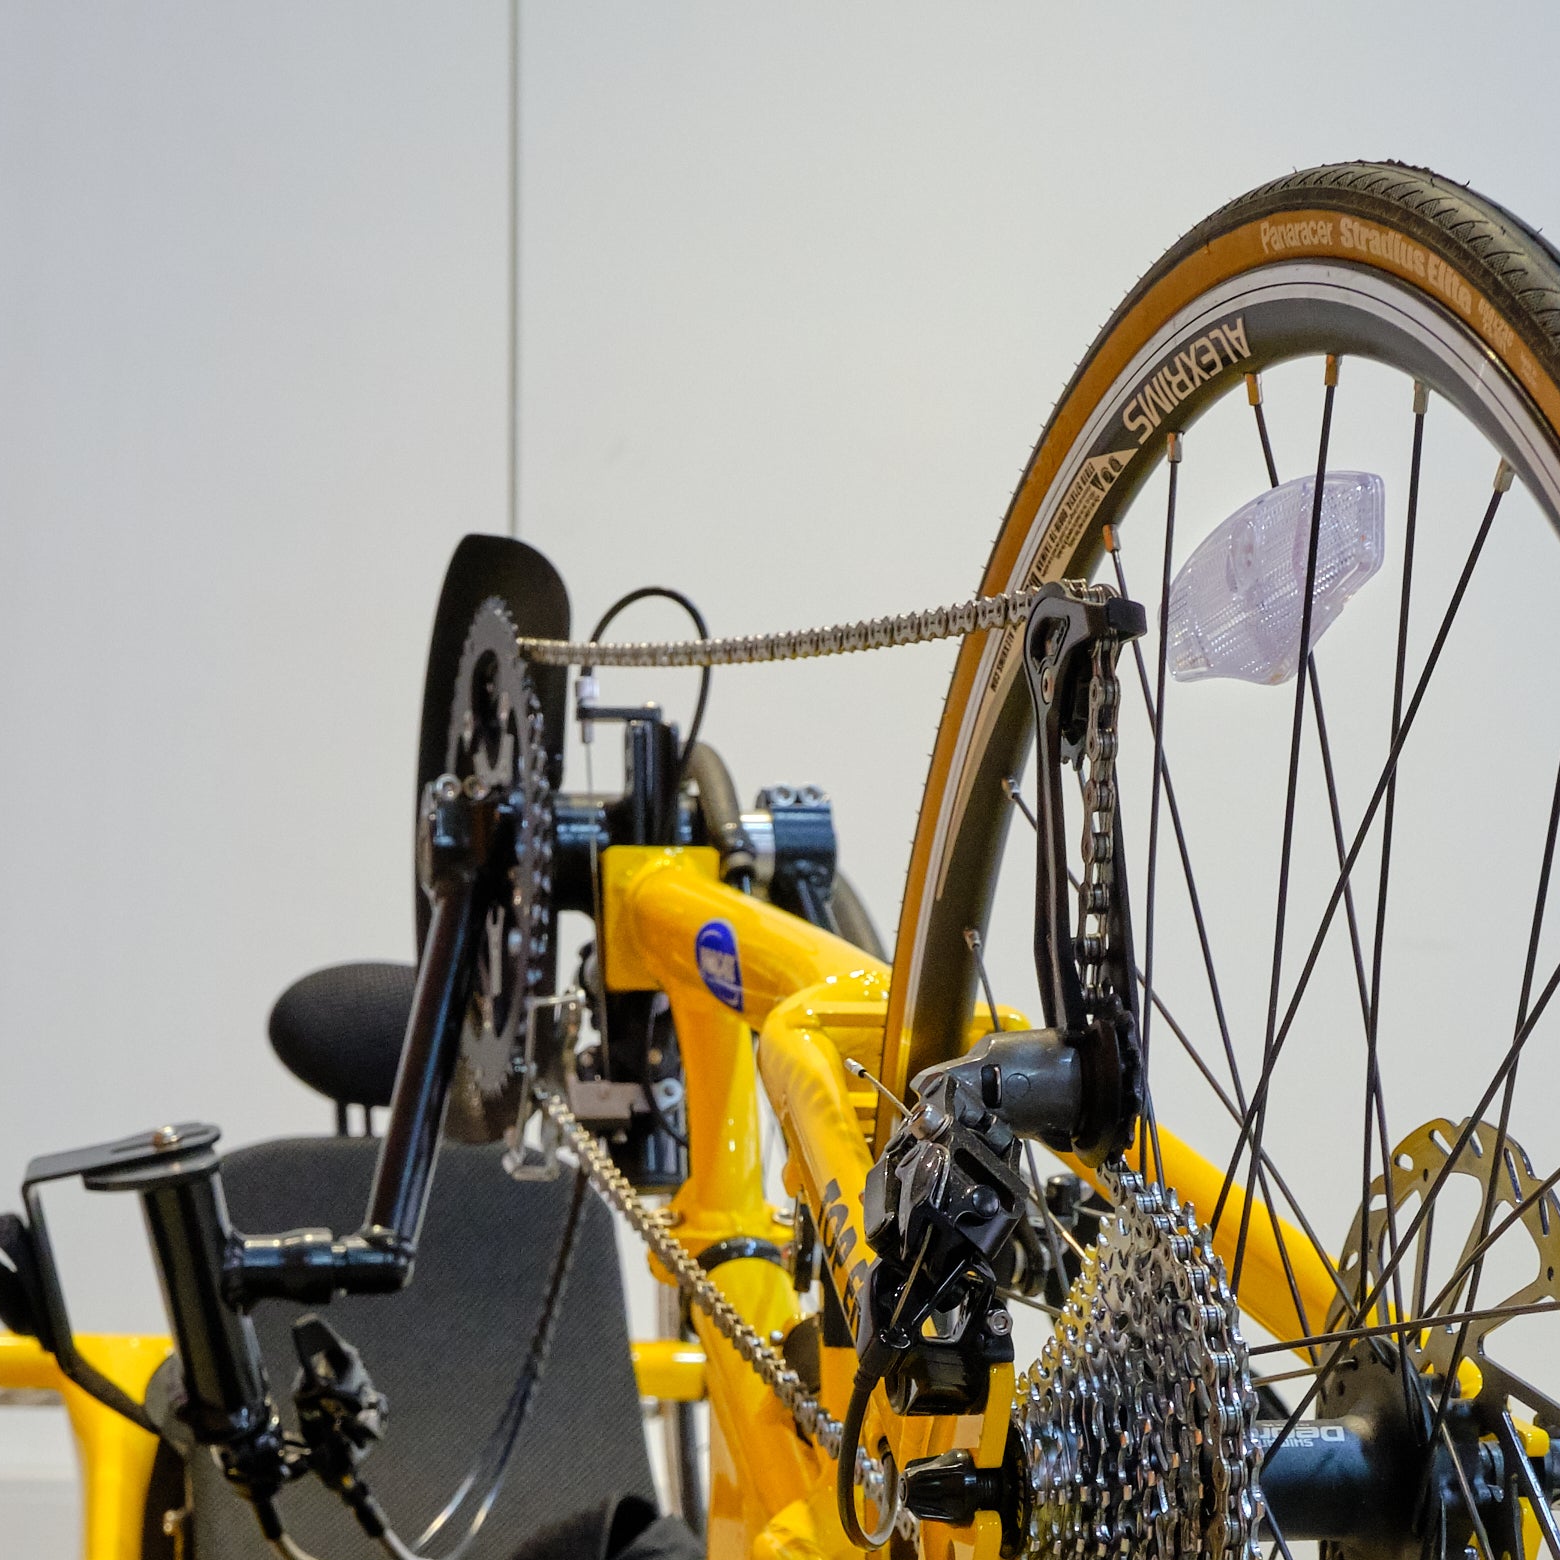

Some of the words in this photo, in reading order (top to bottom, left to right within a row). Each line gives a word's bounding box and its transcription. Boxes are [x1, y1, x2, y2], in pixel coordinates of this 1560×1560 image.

[1260, 219, 1334, 255] Panaracer
[1339, 216, 1427, 278] Stradius
[1427, 259, 1472, 315] Elite
[1122, 318, 1252, 445] ALEXRIMS
